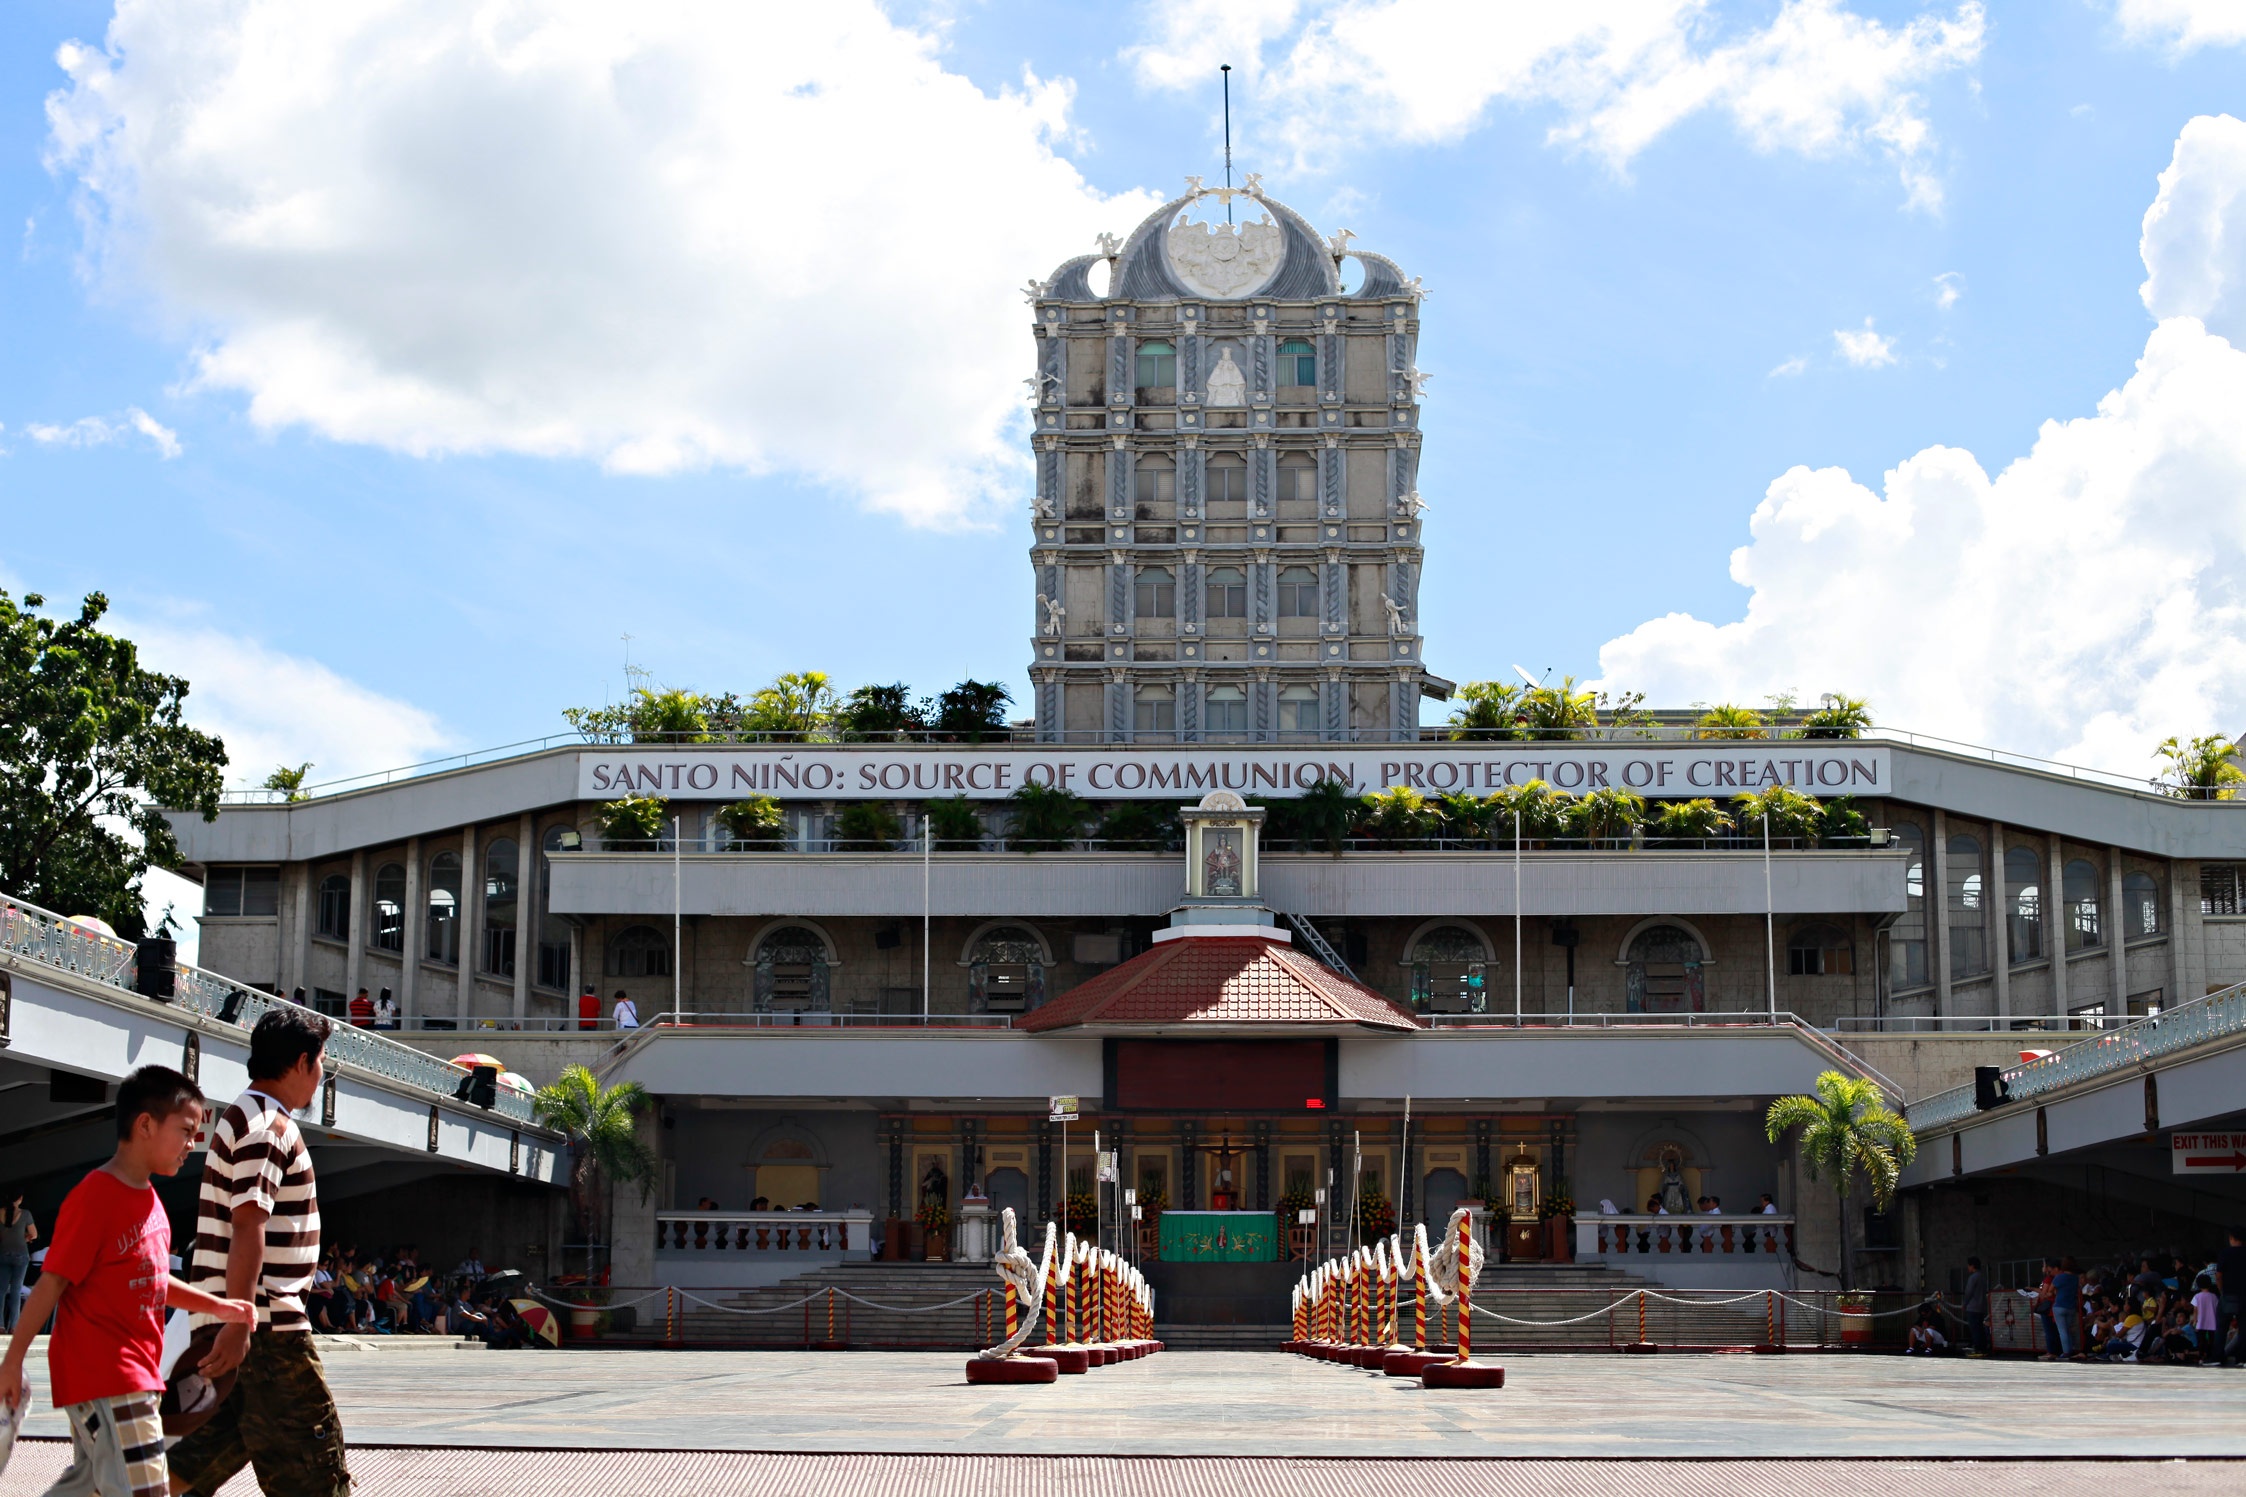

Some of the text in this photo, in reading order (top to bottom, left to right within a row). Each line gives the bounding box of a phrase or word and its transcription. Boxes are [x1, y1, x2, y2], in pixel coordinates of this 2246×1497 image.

[592, 754, 1877, 795] SANTO NIÑO: SOURCE OF COMMUNION, PROTECTOR OF CREATION
[2173, 1135, 2198, 1150] EXIT
[2201, 1134, 2228, 1149] THIS
